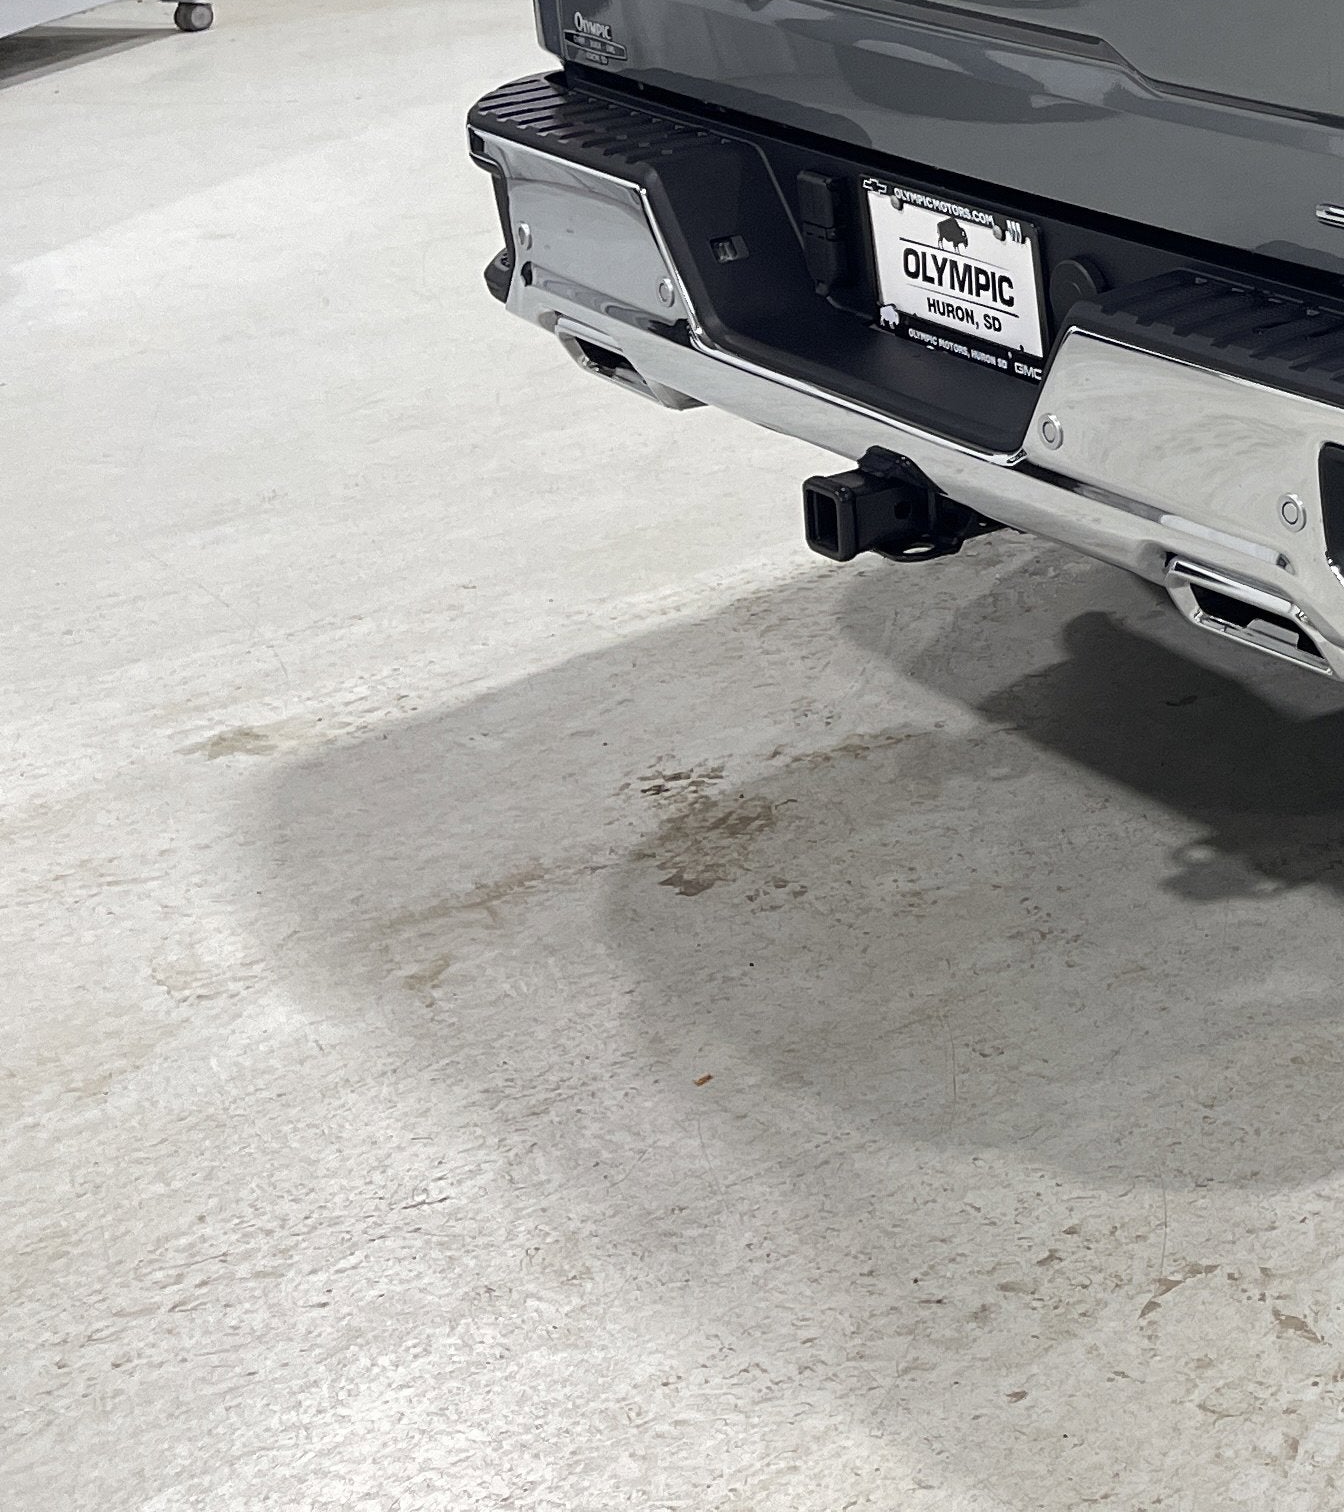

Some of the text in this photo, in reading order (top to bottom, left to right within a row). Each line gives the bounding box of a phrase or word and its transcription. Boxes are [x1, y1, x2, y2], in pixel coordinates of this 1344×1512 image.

[893, 188, 994, 225] OLYMPICMOTORS.COM
[903, 247, 1015, 308] OLYMPIC
[927, 297, 1002, 332] HURON, SD
[908, 328, 1008, 369] OLYMPIC MOTORS, HURON SD
[1014, 362, 1042, 381] GMC
